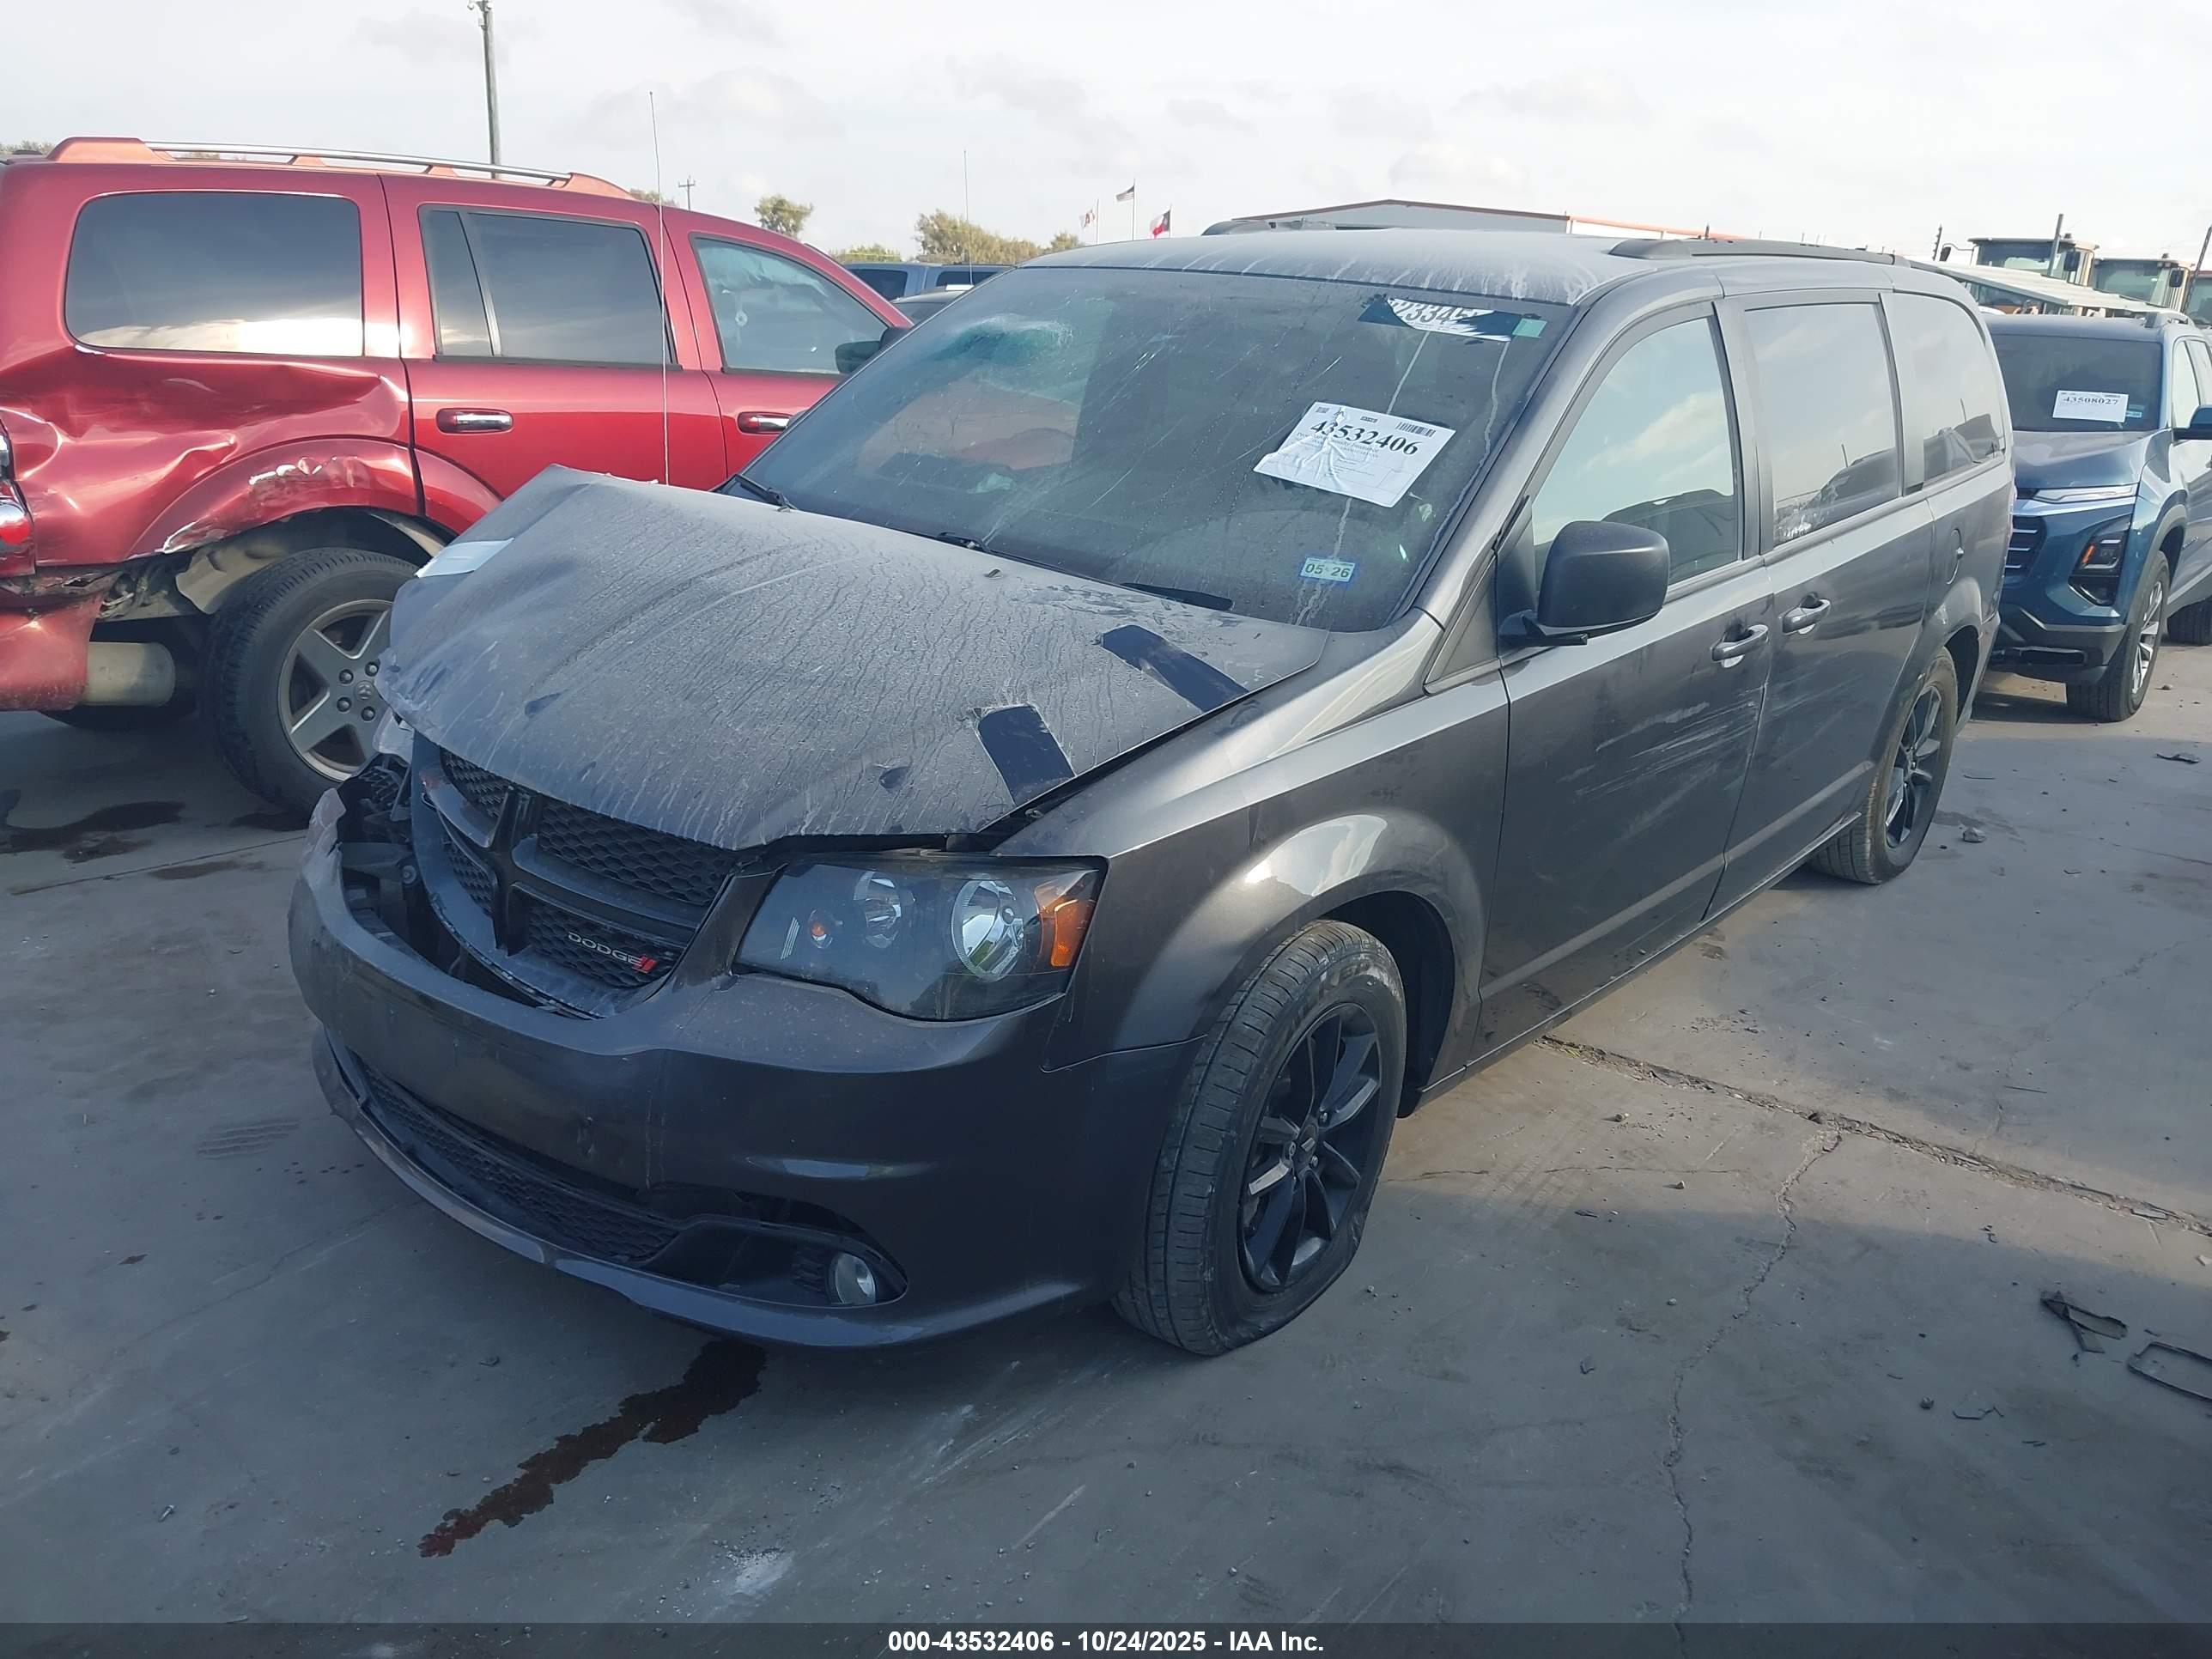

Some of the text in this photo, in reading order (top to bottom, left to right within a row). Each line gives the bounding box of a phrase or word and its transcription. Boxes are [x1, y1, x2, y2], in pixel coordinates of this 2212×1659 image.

[1310, 420, 1424, 456] 43532406
[1304, 562, 1325, 574] 05
[1331, 566, 1352, 578] 26
[568, 931, 643, 967] DODGE
